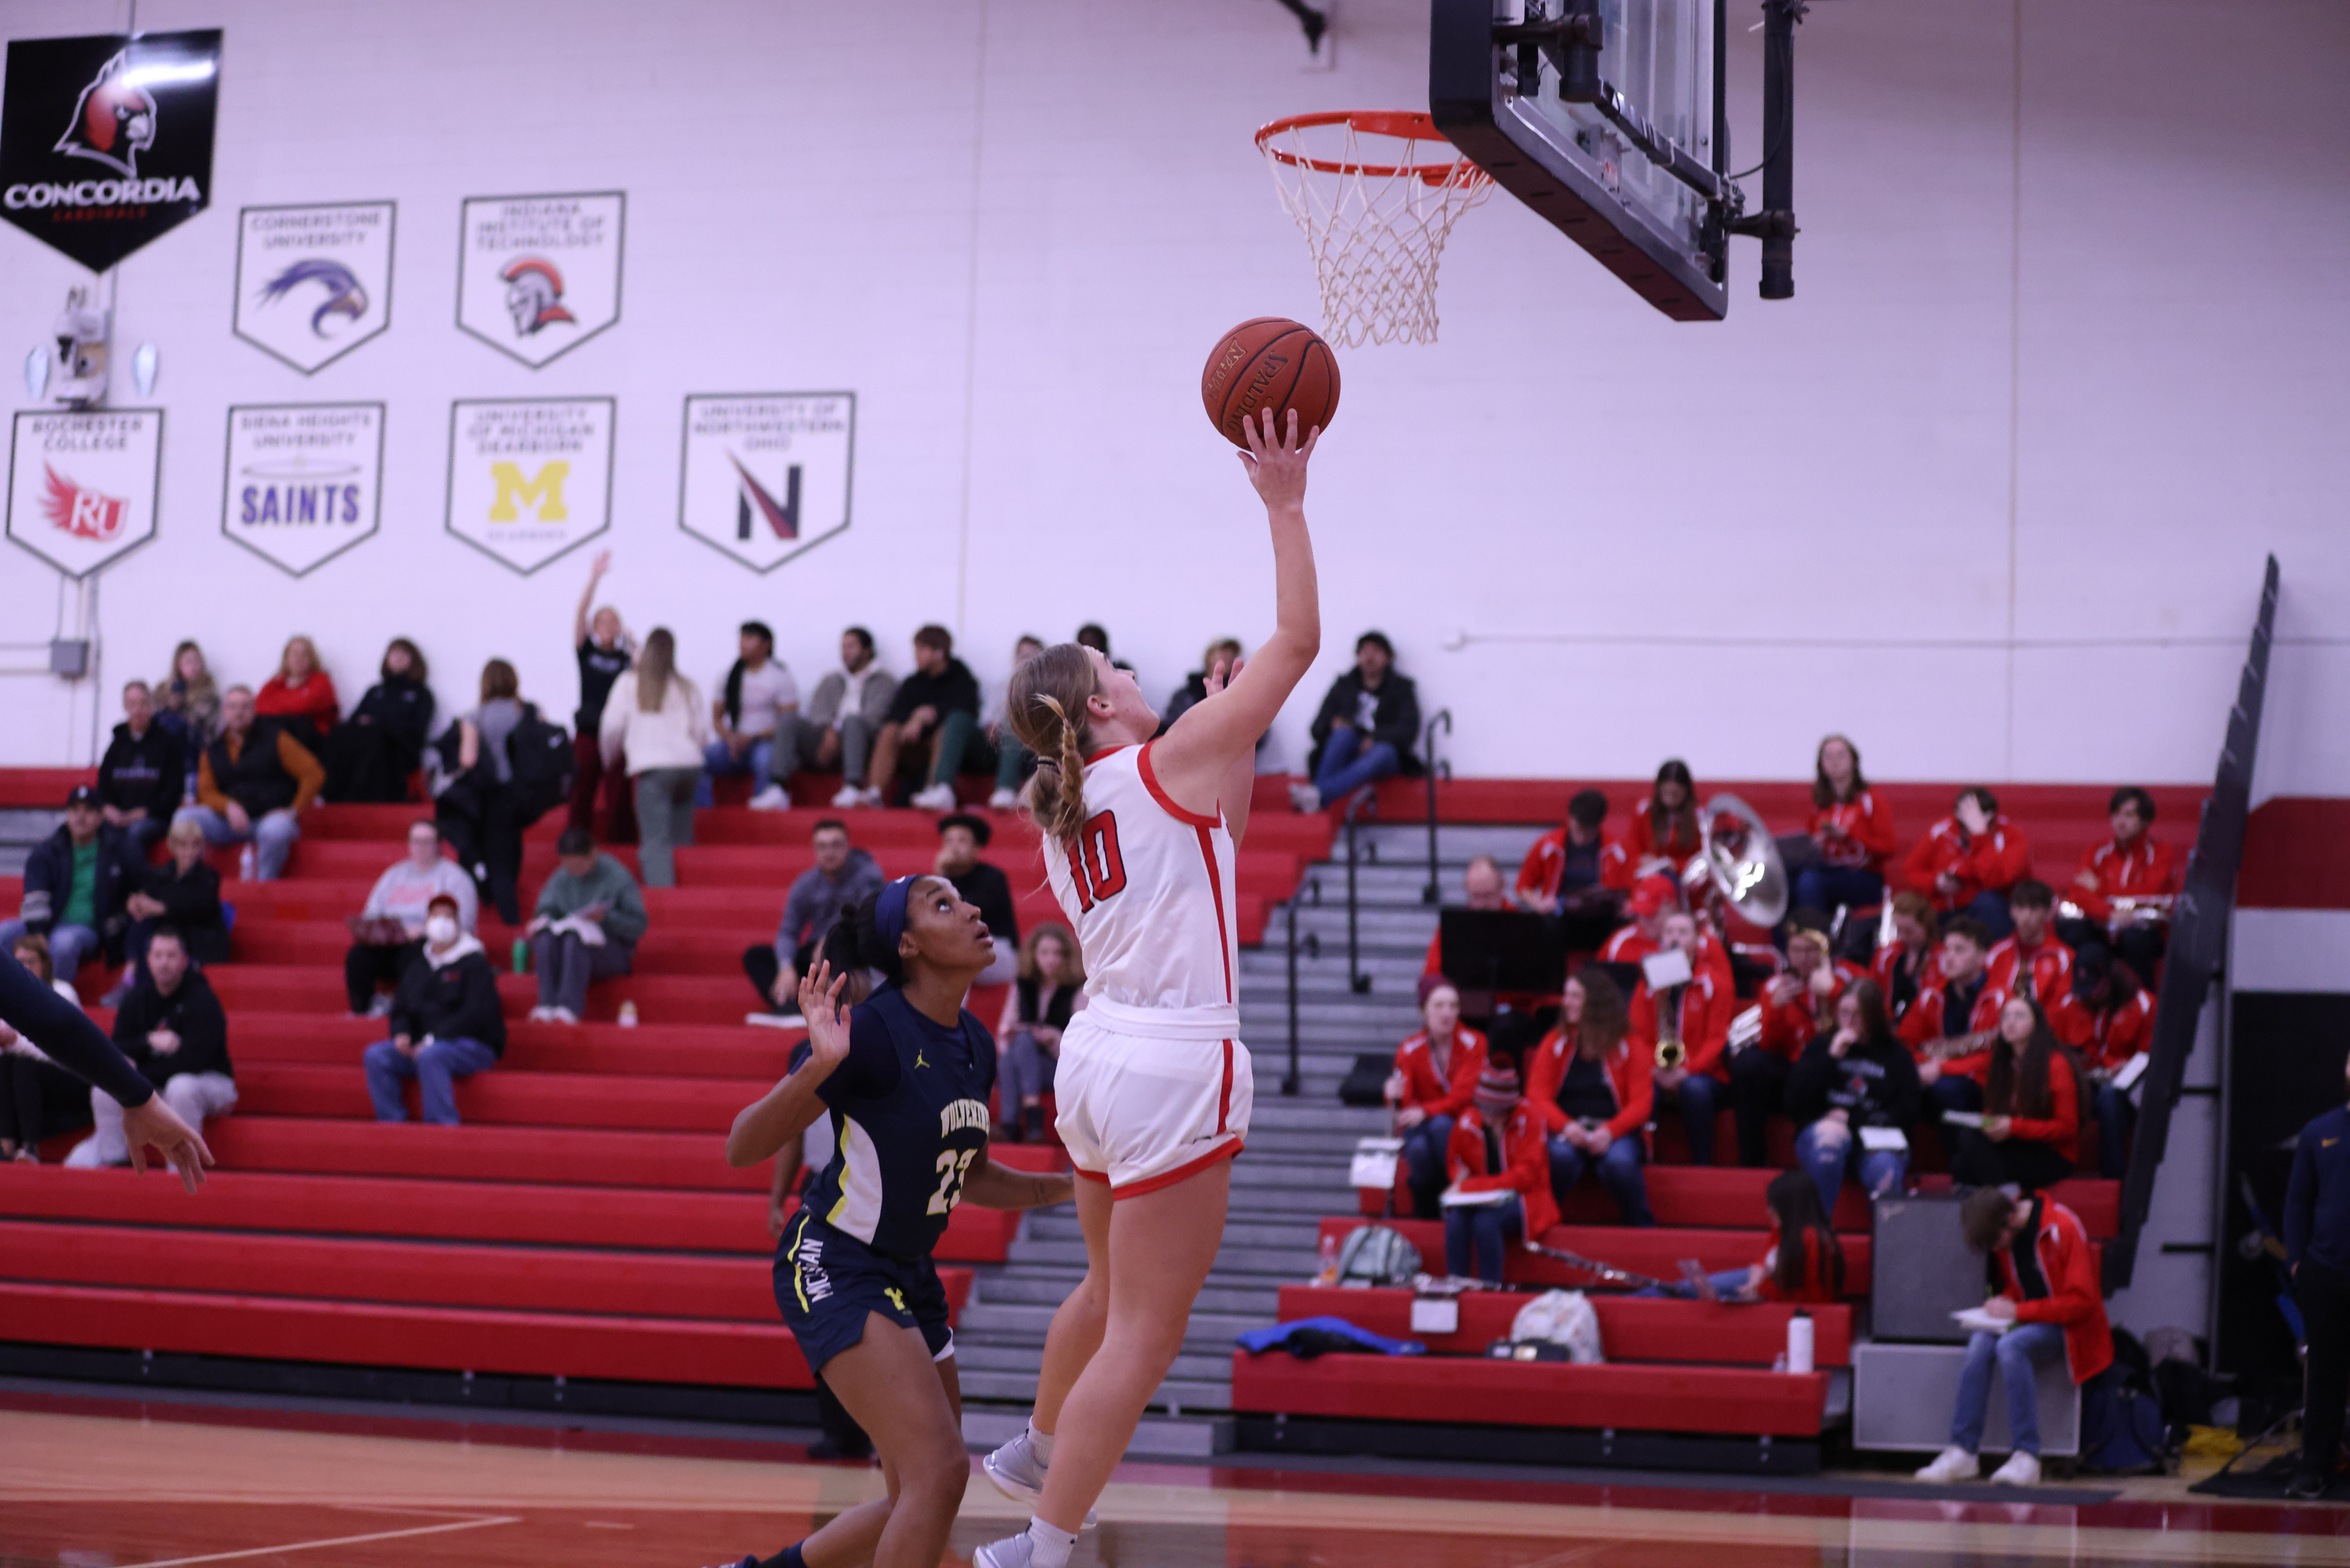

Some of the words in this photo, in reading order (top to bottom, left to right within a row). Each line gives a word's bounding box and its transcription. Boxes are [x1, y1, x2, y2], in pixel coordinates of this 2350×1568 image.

[4, 175, 200, 209] CONCORDIA
[252, 212, 381, 231] CORNERSTONE
[264, 231, 367, 249] UNIVERSITY
[32, 417, 143, 434] ROCHESTER
[43, 433, 128, 450] COLLEGE
[241, 485, 360, 525] SAINTS
[488, 461, 571, 522] M
[70, 489, 130, 541] RU
[1063, 809, 1127, 914] 10
